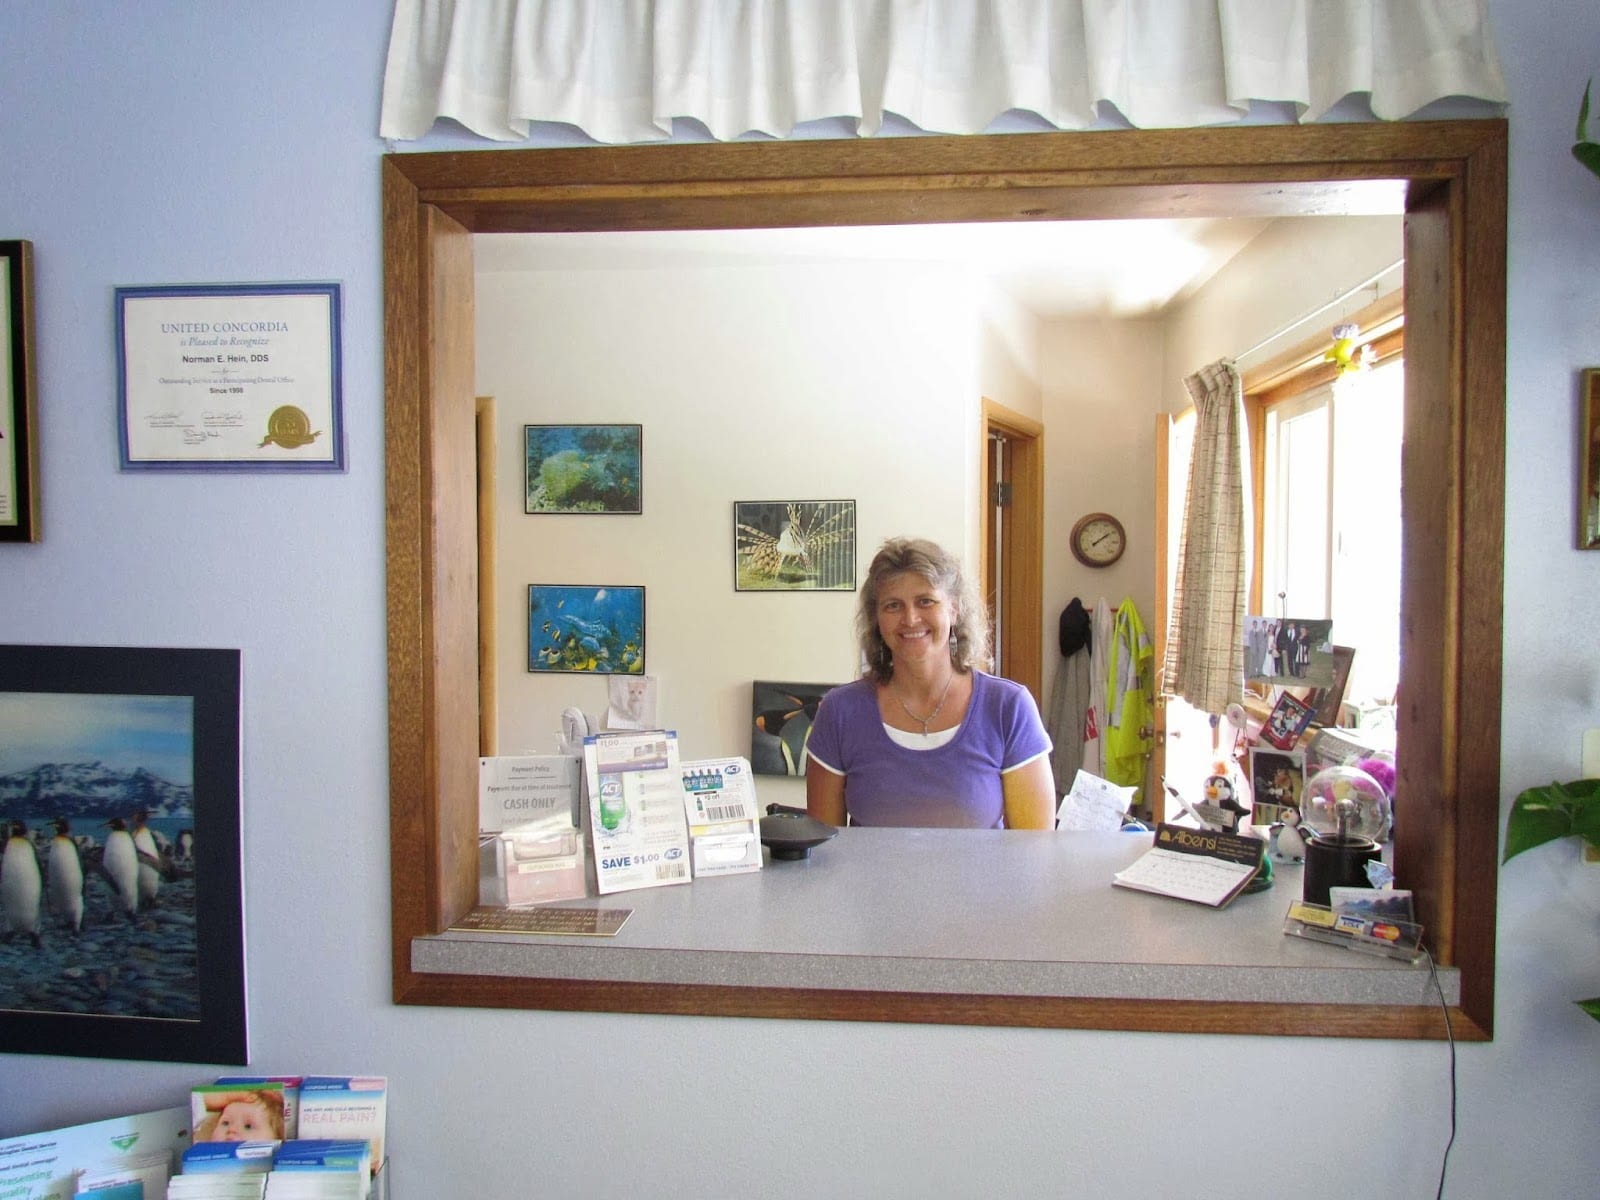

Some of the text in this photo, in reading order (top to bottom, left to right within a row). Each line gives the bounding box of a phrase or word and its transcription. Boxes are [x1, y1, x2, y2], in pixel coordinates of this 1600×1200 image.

[161, 321, 289, 334] UNITED CONCORDIA
[188, 336, 219, 346] Pleased
[220, 337, 228, 346] to
[229, 336, 270, 349] Recognize
[182, 354, 270, 364] Norman E. Hein, DDS
[602, 783, 619, 794] ACT
[503, 797, 556, 810] CASH ONLY
[602, 856, 631, 869] SAVE
[633, 853, 660, 864] $1.00
[303, 1111, 377, 1124] REAL PAIN?
